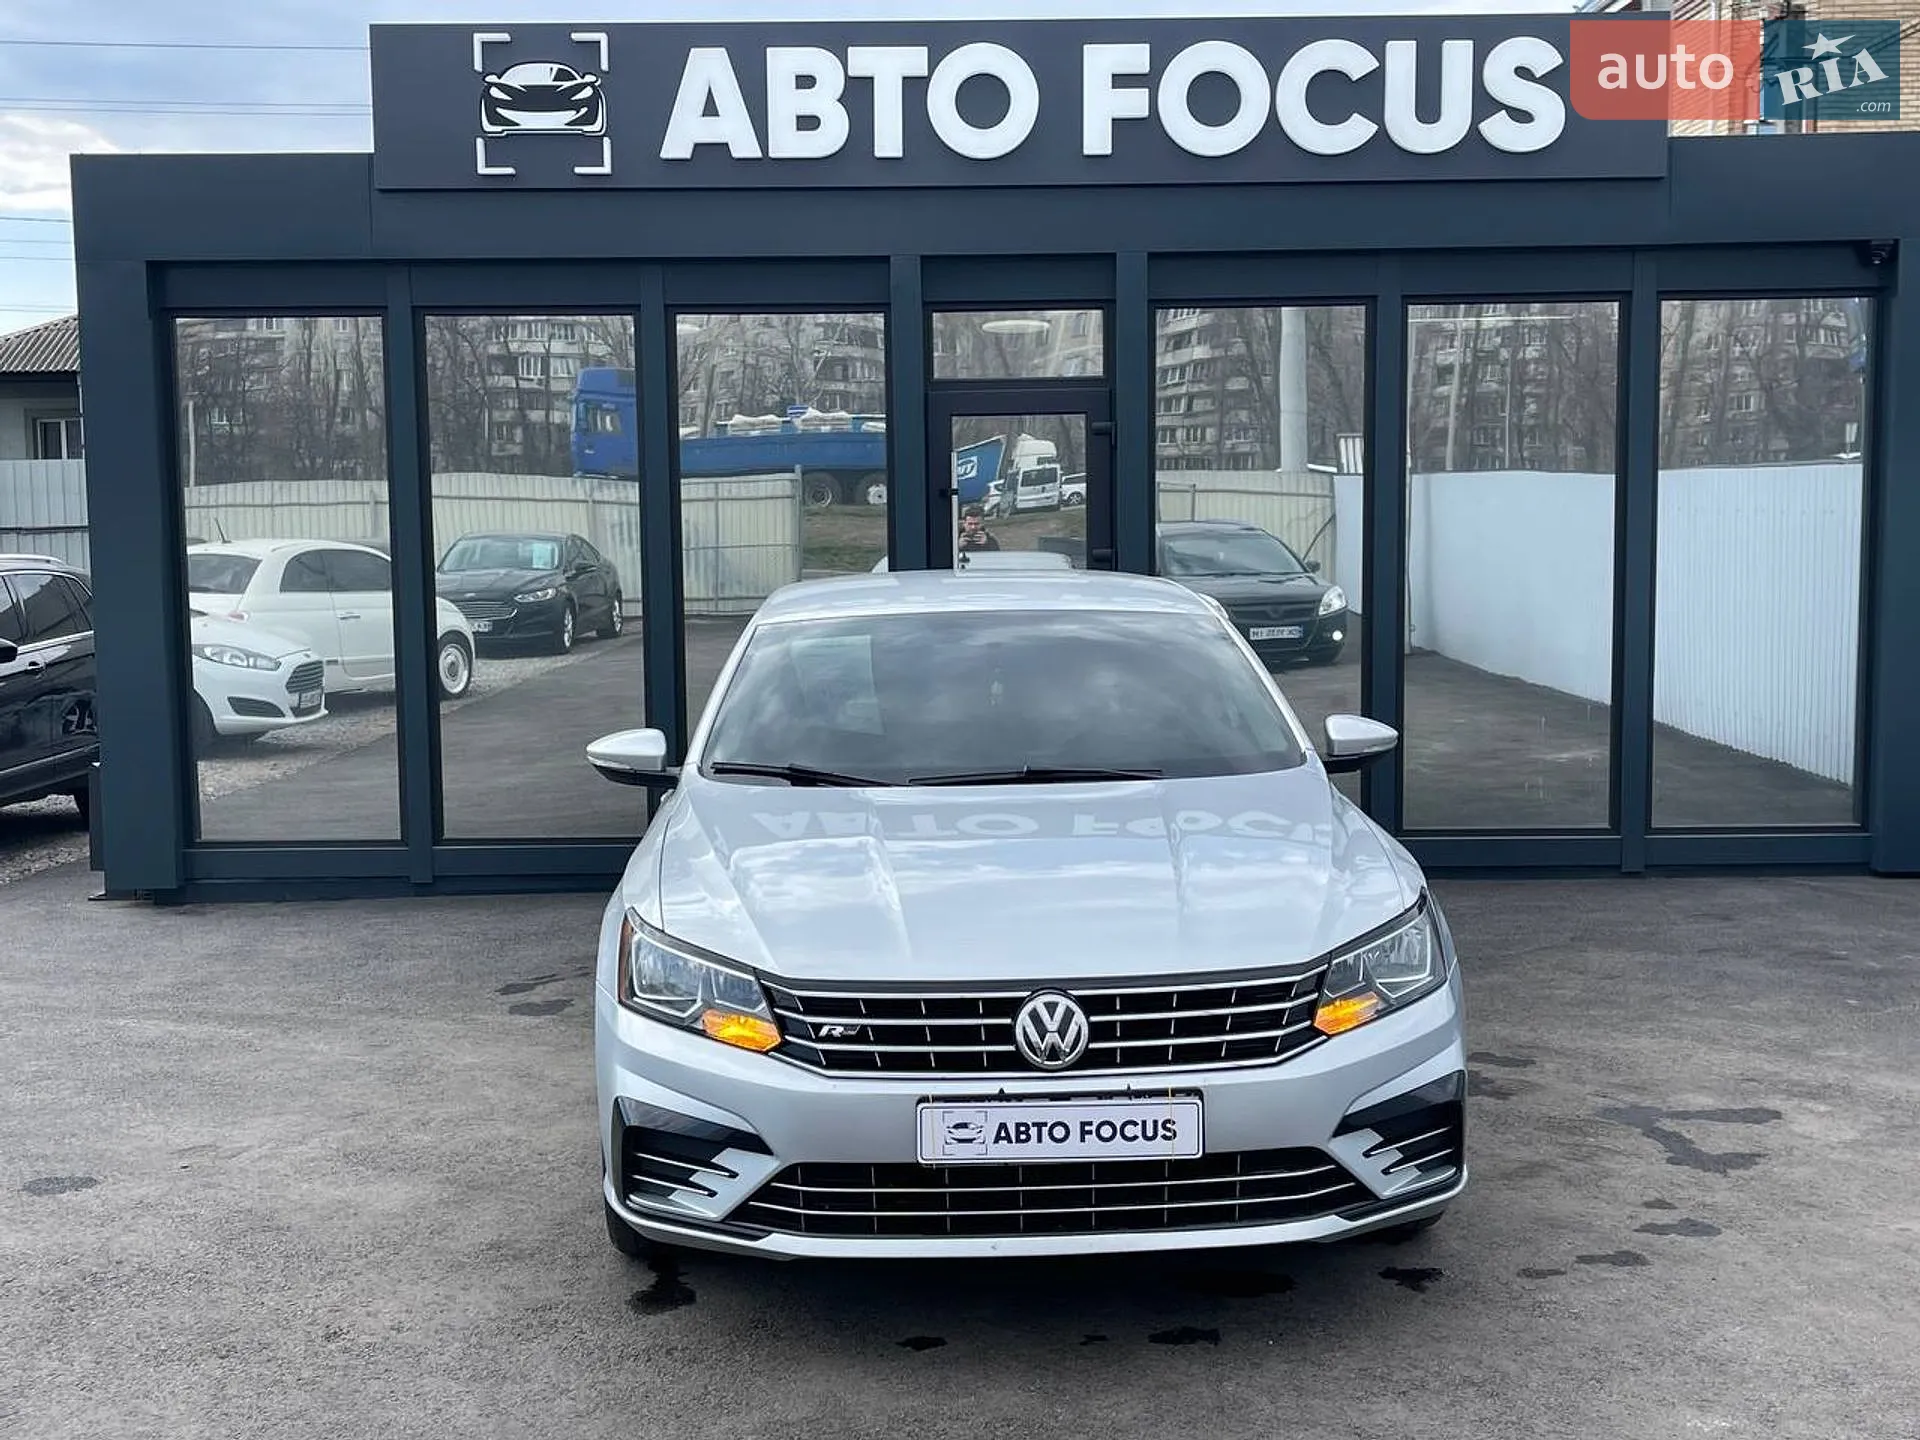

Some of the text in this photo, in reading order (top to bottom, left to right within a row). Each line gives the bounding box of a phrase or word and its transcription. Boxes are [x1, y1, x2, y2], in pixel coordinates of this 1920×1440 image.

[659, 36, 1567, 160] АВТО FOCUS
[992, 1118, 1178, 1145] АВТО FOCUS
